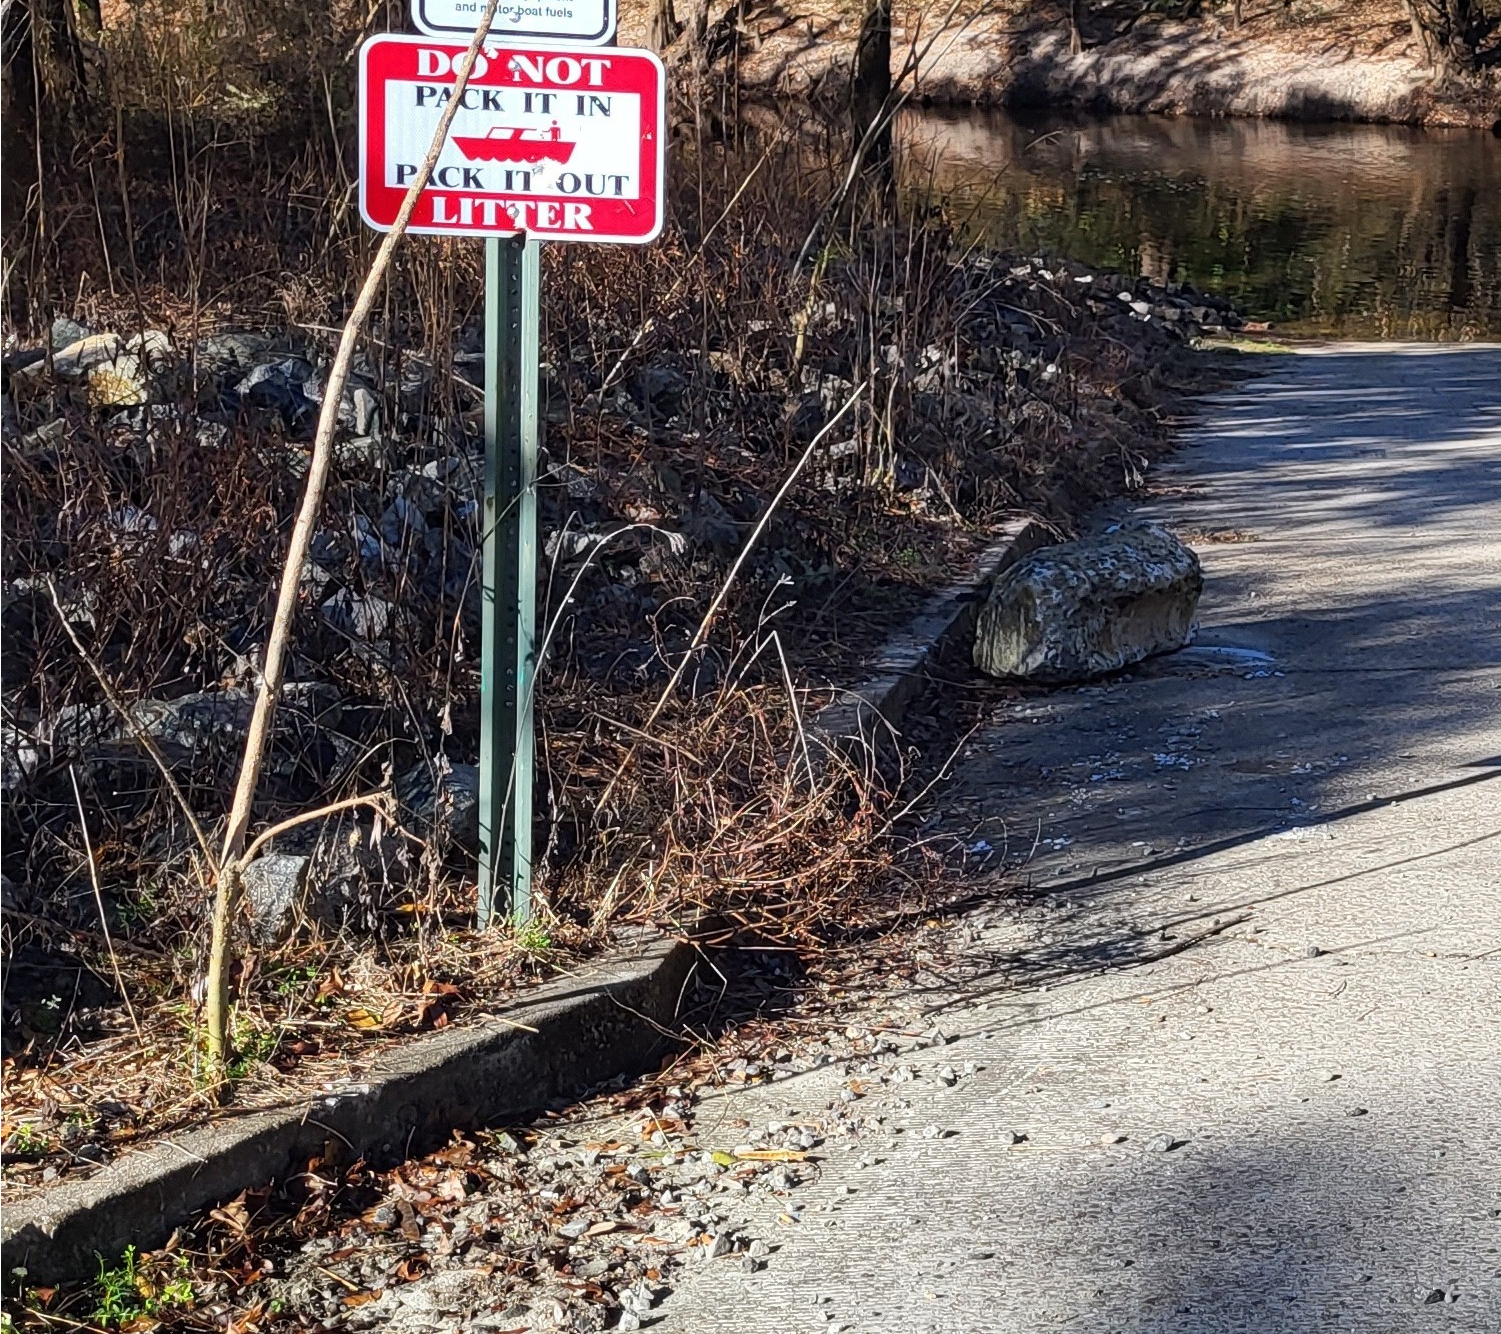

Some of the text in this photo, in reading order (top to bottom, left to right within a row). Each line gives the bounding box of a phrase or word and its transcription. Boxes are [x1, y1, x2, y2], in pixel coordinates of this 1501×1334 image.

[455, 2, 573, 18] and tor boat fuels
[417, 49, 612, 86] DO NOT
[415, 85, 612, 117] PACK IT IN
[504, 169, 533, 192] IT
[555, 172, 630, 196] OUT
[431, 196, 595, 231] LITTER
